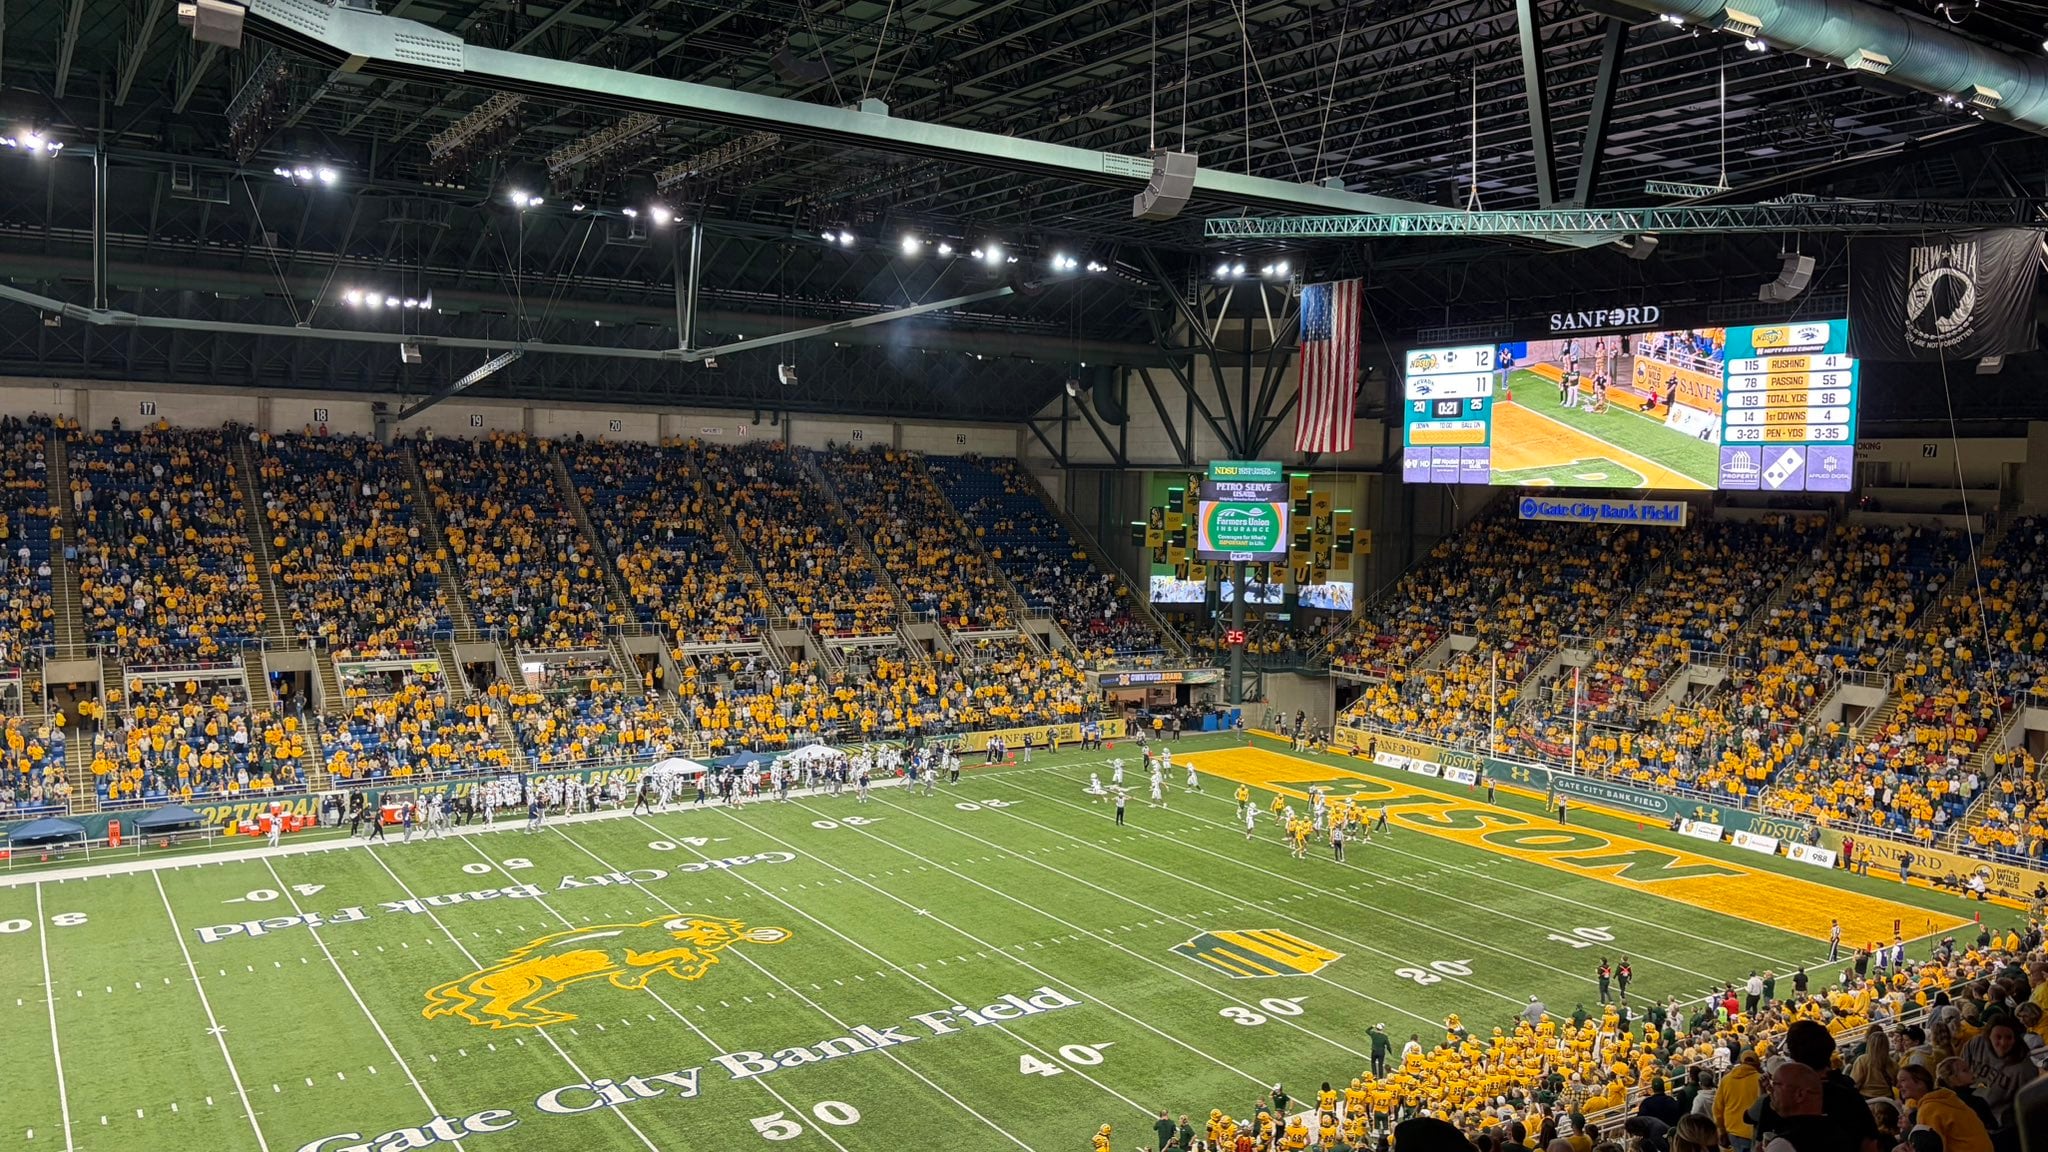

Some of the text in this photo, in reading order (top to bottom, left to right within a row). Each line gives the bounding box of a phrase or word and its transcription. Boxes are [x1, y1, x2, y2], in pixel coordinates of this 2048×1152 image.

[1909, 242, 1977, 291] POW MIA
[1550, 305, 1660, 331] SANFORD
[1476, 351, 1489, 366] 12
[1745, 356, 1836, 370] 115 RUSHING 41
[1476, 377, 1486, 392] 11
[1744, 374, 1837, 388] 78 PASSING 55
[1742, 393, 1836, 406] 193 TOTAL YDS 96
[141, 402, 154, 414] 17
[315, 409, 327, 421] 18
[1438, 401, 1458, 415] 0:21
[471, 415, 483, 427] 19
[1744, 412, 1754, 422] 14
[1777, 411, 1806, 420] DOWNS
[1823, 410, 1831, 420] 4
[610, 420, 621, 431] 20
[737, 426, 748, 436] 21
[853, 430, 863, 440] 22
[1737, 429, 1760, 440] 3-23
[1766, 429, 1781, 438] PEN
[1787, 428, 1804, 438] YDS
[1814, 428, 1839, 439] 3-35
[1923, 445, 1936, 457] 27
[1214, 466, 1238, 475] NDSU
[1216, 482, 1272, 491] PETRO SERVE
[1538, 501, 1680, 522] Gate City Bank Field
[1216, 516, 1270, 526] Farmers Union
[1227, 631, 1244, 643] 25
[1437, 753, 1475, 769] NDSU
[1558, 780, 1662, 808] GATE CITY BANK FIELD
[201, 802, 268, 825] ORTH
[1263, 776, 1752, 884] BISON
[1748, 817, 1800, 844] NDSU
[1812, 853, 1828, 863] 988
[1996, 873, 2020, 884] WILD
[1996, 880, 2019, 889] WINGS
[194, 851, 799, 944] Gate City Bank Field
[1548, 926, 1616, 950] 10
[1395, 960, 1474, 986] 20
[1218, 996, 1304, 1027] 30
[536, 1067, 700, 1117] City
[710, 1024, 921, 1082] Bank
[909, 986, 1084, 1036] Field
[1018, 1040, 1108, 1080] 40
[749, 1099, 863, 1143] 50
[1292, 1133, 1303, 1143] 68
